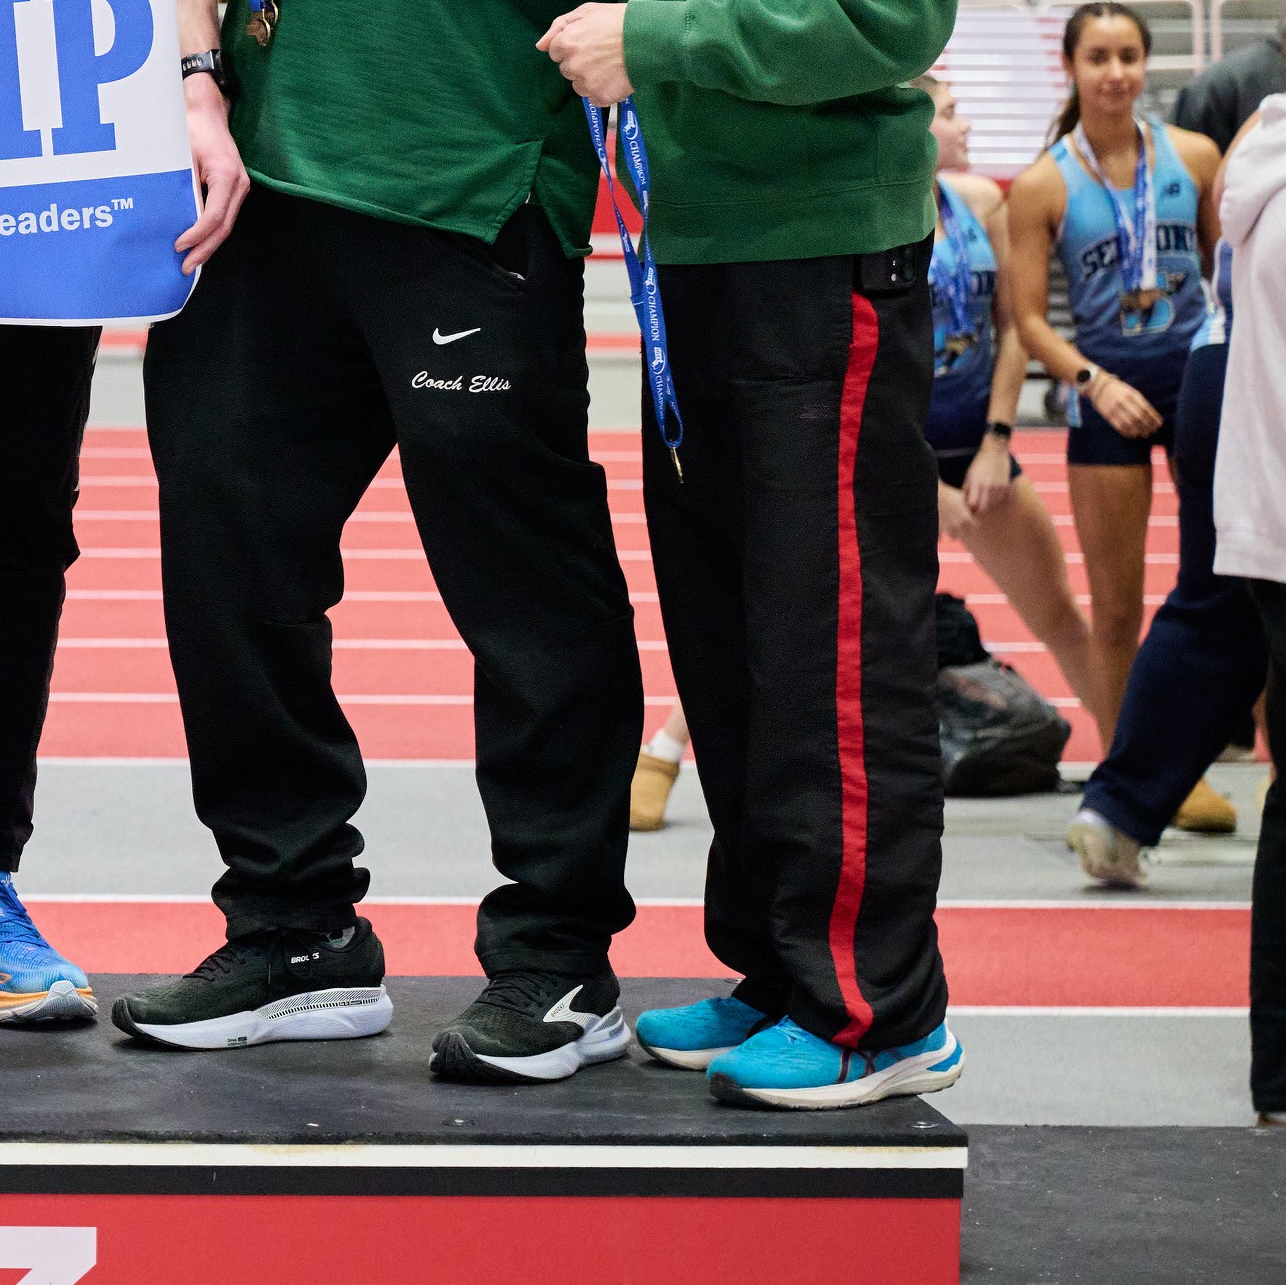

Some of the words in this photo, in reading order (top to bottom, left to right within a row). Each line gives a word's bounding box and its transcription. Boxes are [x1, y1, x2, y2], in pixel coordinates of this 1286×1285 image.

[629, 140, 647, 185] CHAMPION
[648, 296, 660, 342] CHAMPION
[411, 371, 463, 391] Coach
[469, 375, 512, 393] Ellis
